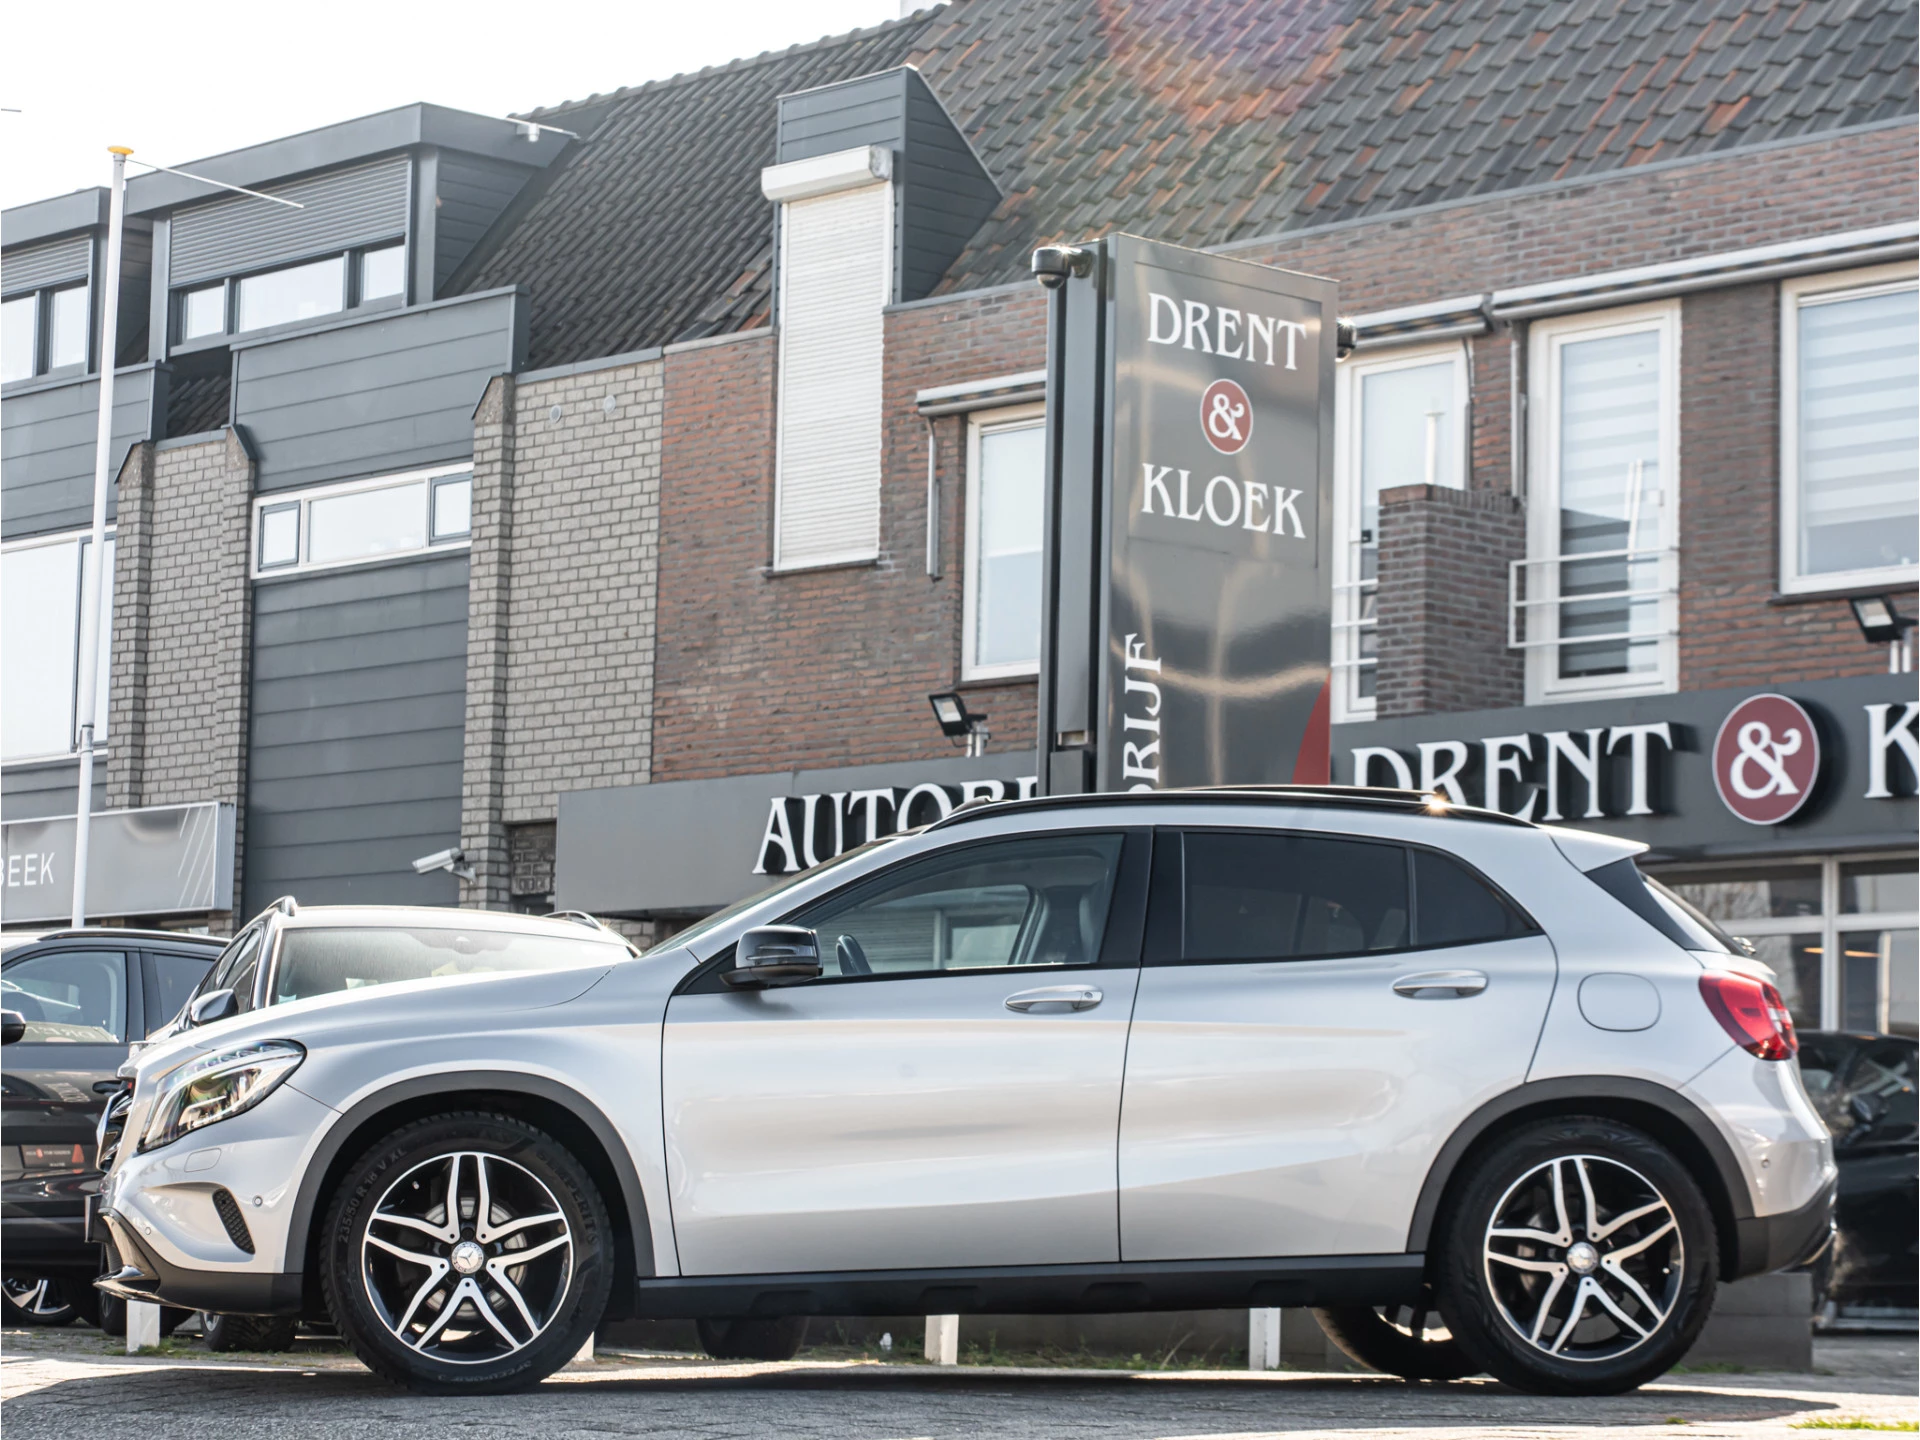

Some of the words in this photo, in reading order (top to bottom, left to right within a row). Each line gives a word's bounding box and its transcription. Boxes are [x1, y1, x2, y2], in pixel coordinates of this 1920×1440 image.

[1147, 292, 1307, 371] DRENT
[1208, 393, 1245, 441] &
[1141, 462, 1306, 539] KLOEK
[1122, 633, 1162, 792] RIJF
[1730, 721, 1802, 799] &
[752, 776, 1038, 874] AUTO
